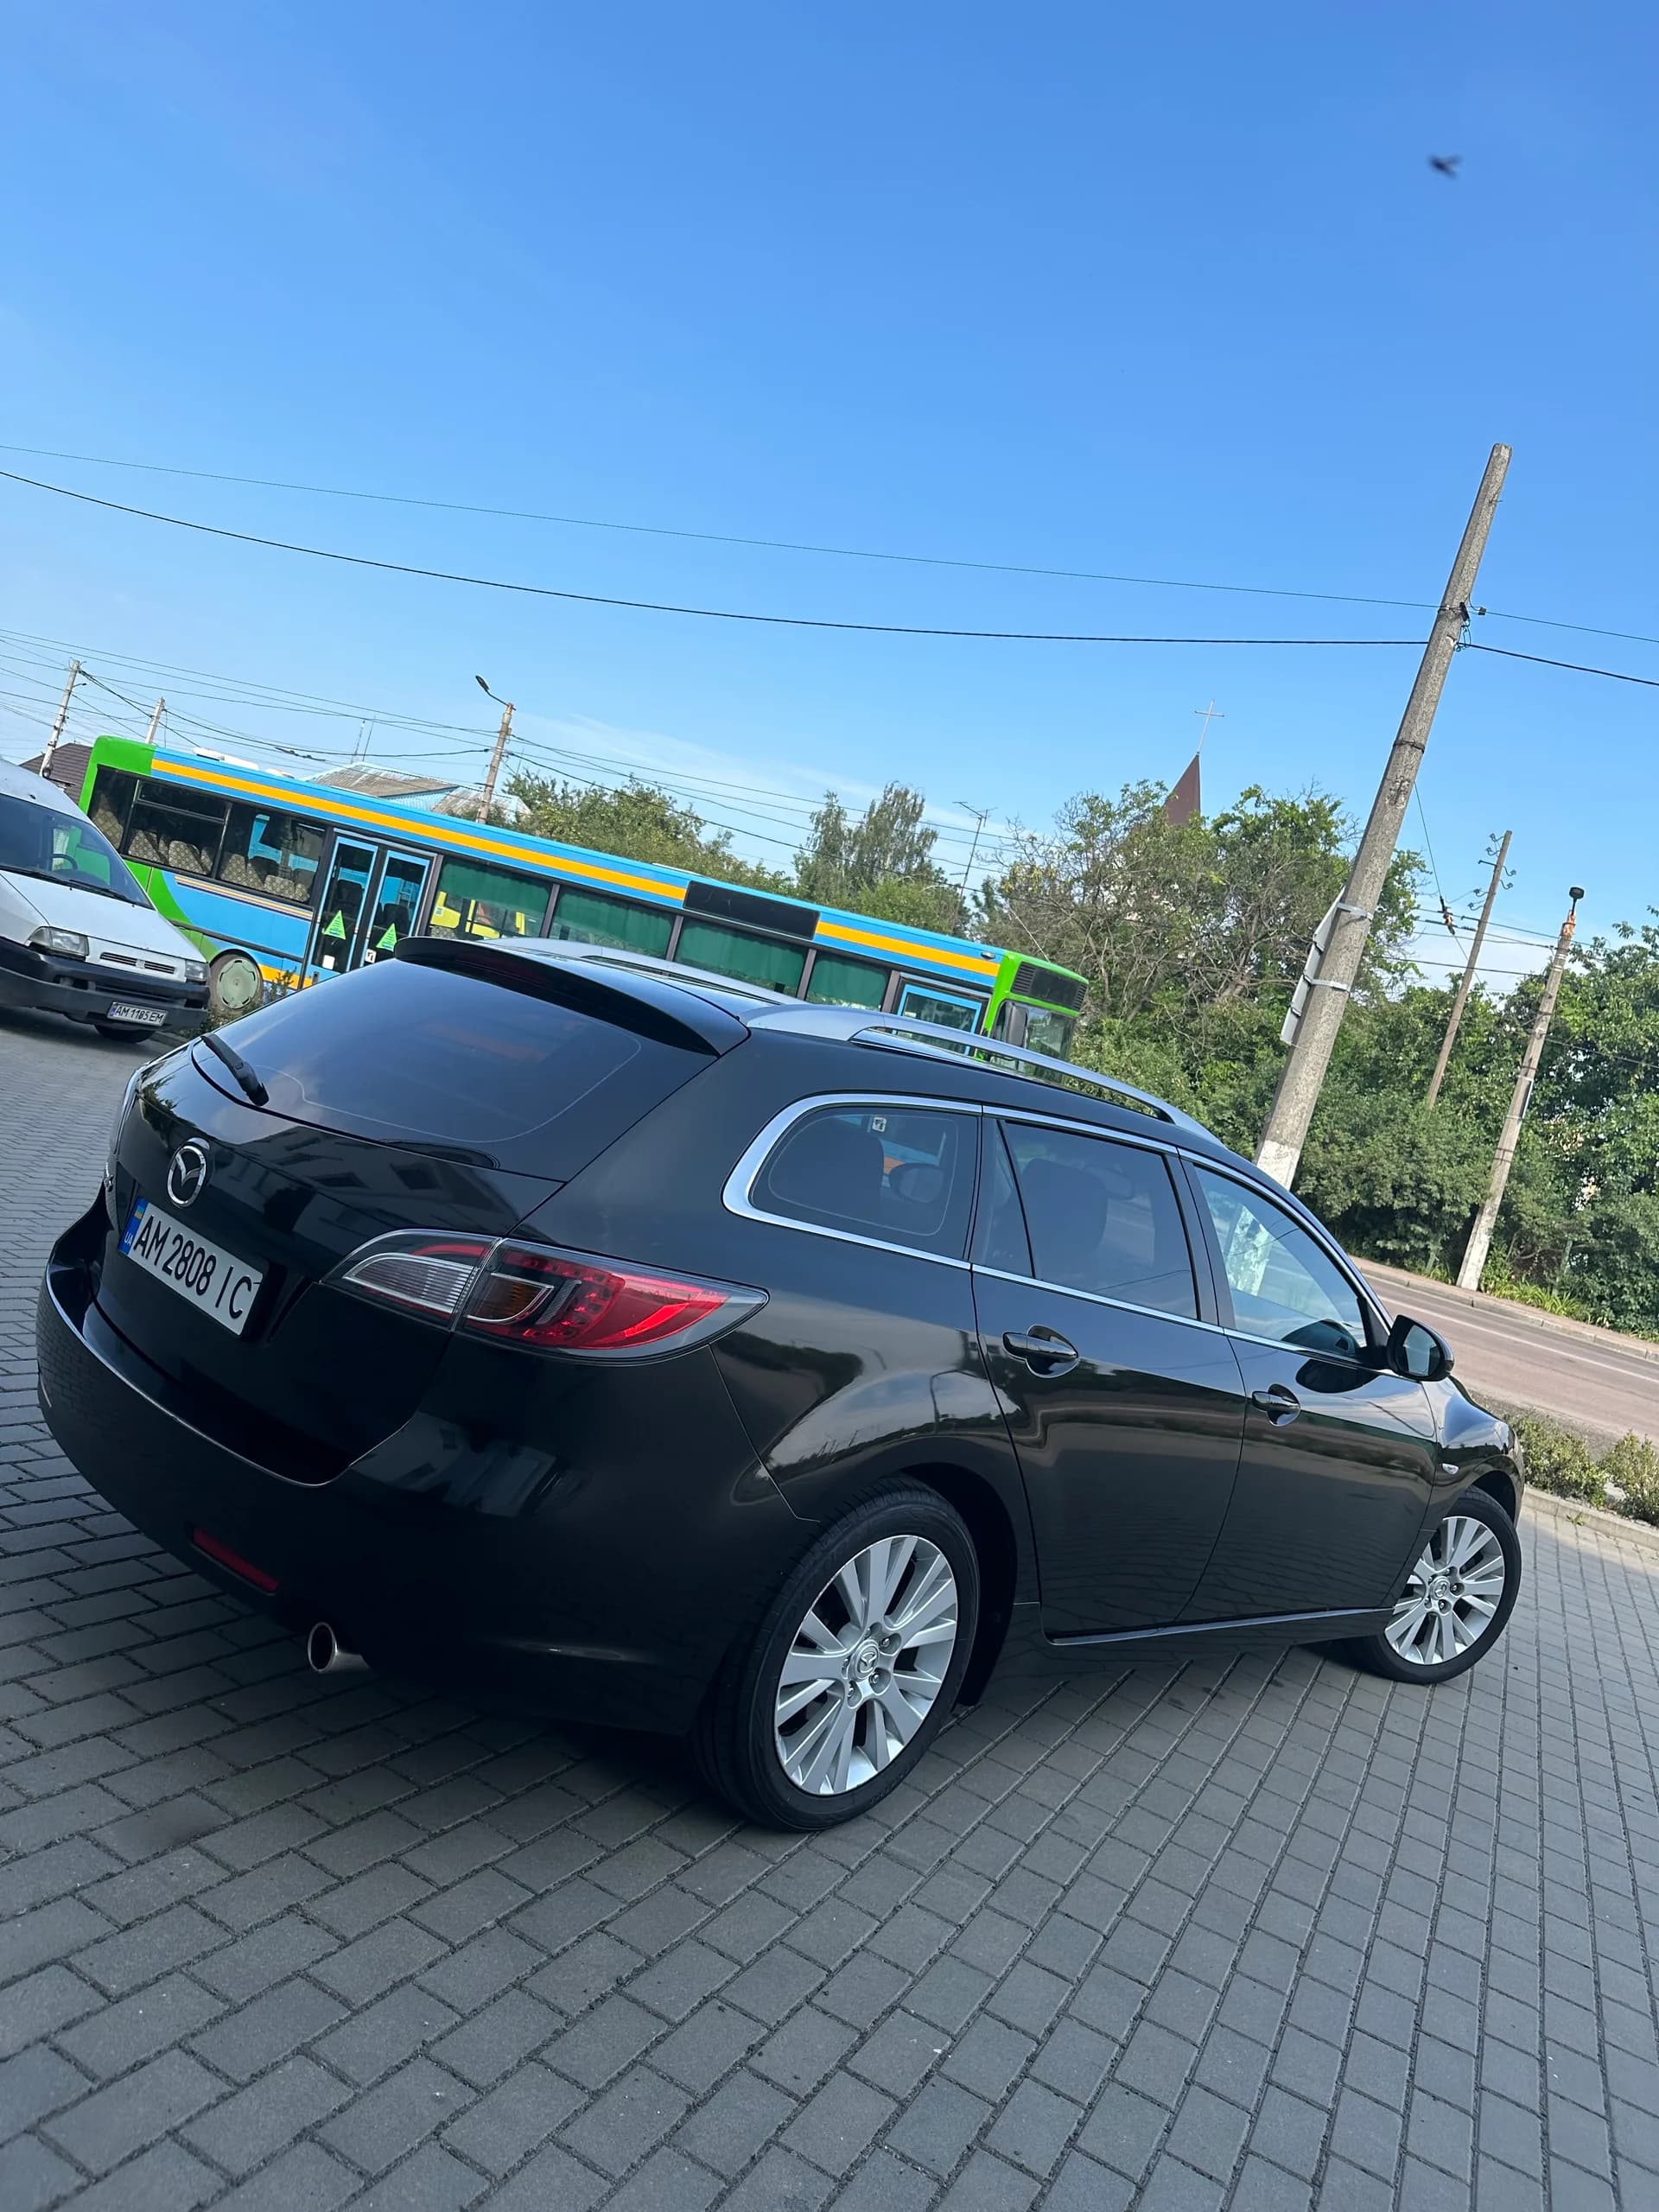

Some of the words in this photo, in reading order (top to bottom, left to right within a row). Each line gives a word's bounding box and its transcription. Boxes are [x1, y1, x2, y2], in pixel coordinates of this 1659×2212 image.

[116, 1006, 130, 1017] AM
[124, 1231, 134, 1246] UA
[133, 1214, 171, 1267] AM
[162, 1232, 217, 1296] 2808
[215, 1264, 252, 1319] IC
